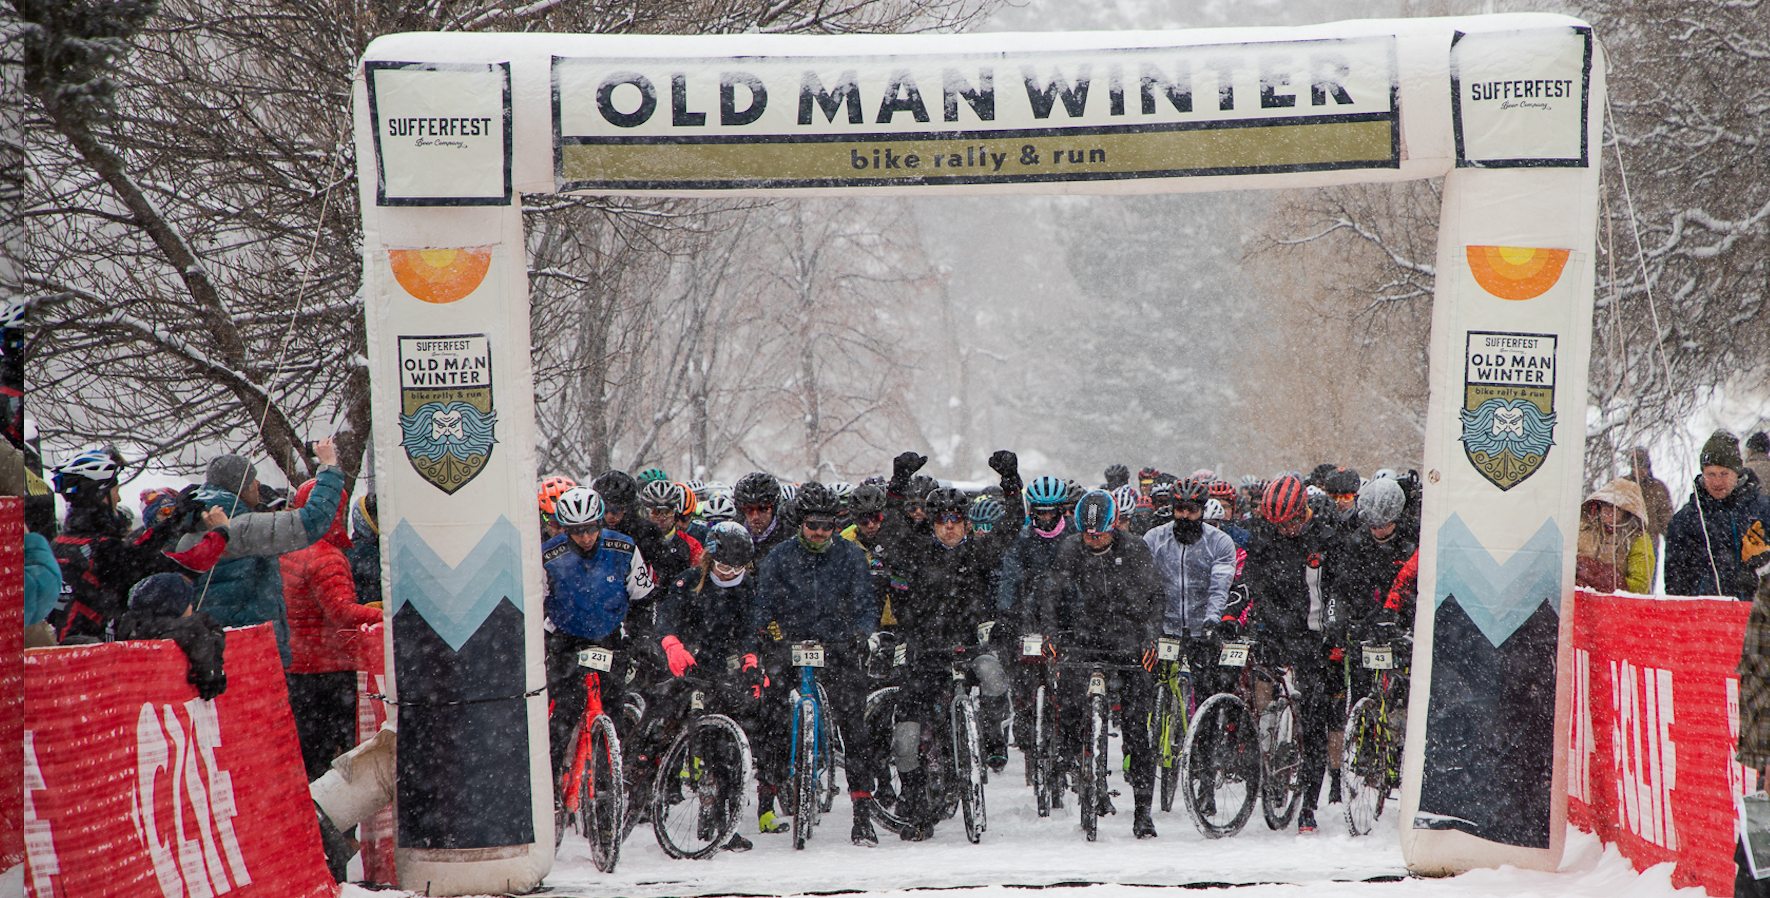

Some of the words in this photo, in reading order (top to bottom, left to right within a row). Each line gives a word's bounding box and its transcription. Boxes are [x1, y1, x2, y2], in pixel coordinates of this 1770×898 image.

[596, 71, 768, 128] OLD
[797, 66, 996, 126] MAN
[1018, 52, 1355, 120] WINTER
[1472, 80, 1573, 101] SUFFERFEST
[388, 117, 492, 137] SUFFERFEST
[415, 137, 433, 148] Beer
[851, 148, 921, 170] bike
[933, 146, 1007, 172] rally
[1018, 144, 1040, 166] &
[1053, 148, 1106, 165] run
[416, 340, 470, 351] SUFFERFEST
[1486, 337, 1539, 348] SUFFERFEST
[404, 358, 439, 371] OLD
[444, 356, 486, 370] MAN
[1471, 353, 1506, 366] OLD
[1511, 355, 1551, 369] MAN
[411, 371, 480, 385] WINTER
[1477, 368, 1544, 382] WINTER
[411, 392, 430, 400] bike
[433, 392, 455, 401] rally
[1475, 387, 1495, 396] bike
[1497, 388, 1519, 397] rally
[1529, 390, 1545, 398] run
[1166, 645, 1172, 653] 8
[591, 652, 607, 662] 231
[804, 652, 819, 660] 133
[1229, 651, 1244, 659] 272
[1375, 654, 1385, 662] 43
